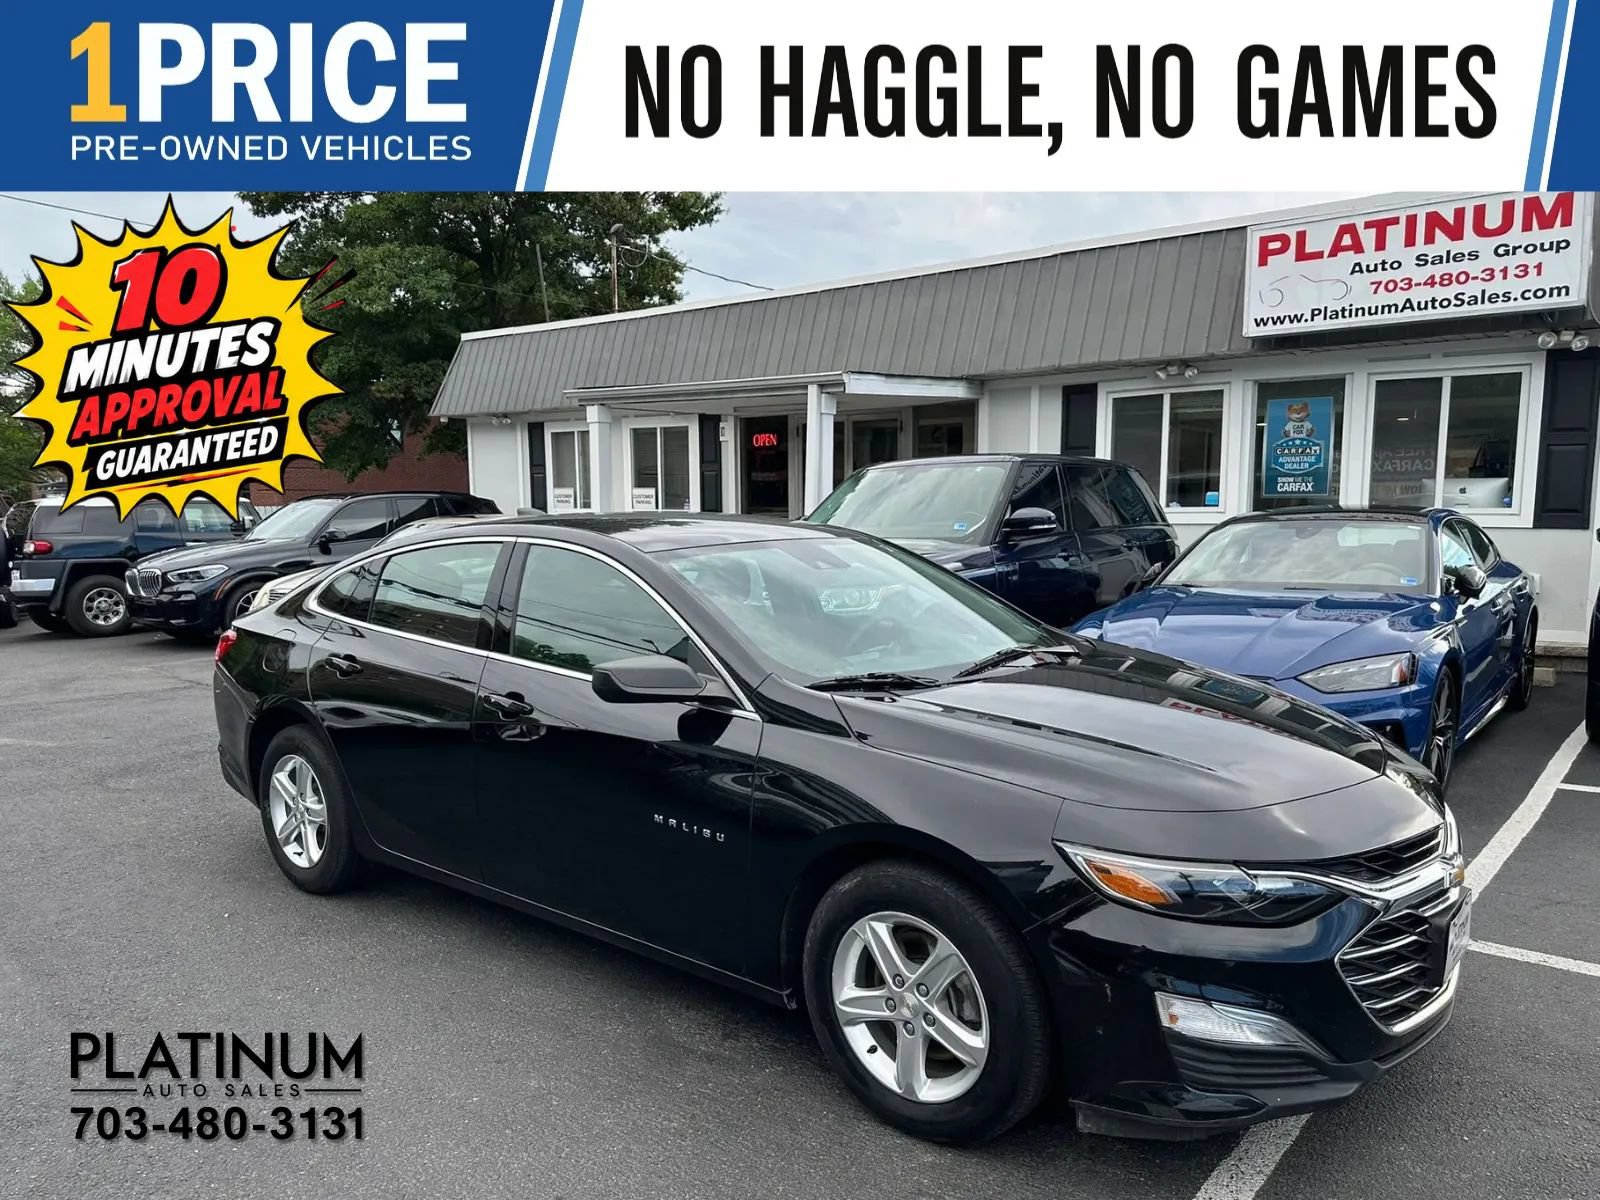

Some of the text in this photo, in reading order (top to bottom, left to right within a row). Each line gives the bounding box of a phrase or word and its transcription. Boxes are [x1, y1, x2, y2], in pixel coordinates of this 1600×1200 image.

[1258, 191, 1575, 267] PLATINUM
[1350, 238, 1572, 276] Auto Sales Group
[1369, 261, 1544, 295] 703-480-3131
[1253, 284, 1571, 328] www.PlatinumAutoSales.com
[752, 433, 777, 447] OPEN
[1276, 446, 1320, 455] CARFAX
[1278, 455, 1316, 463] ADVANTAGE
[1277, 482, 1313, 492] CARFAX
[654, 814, 725, 842] MALIBU
